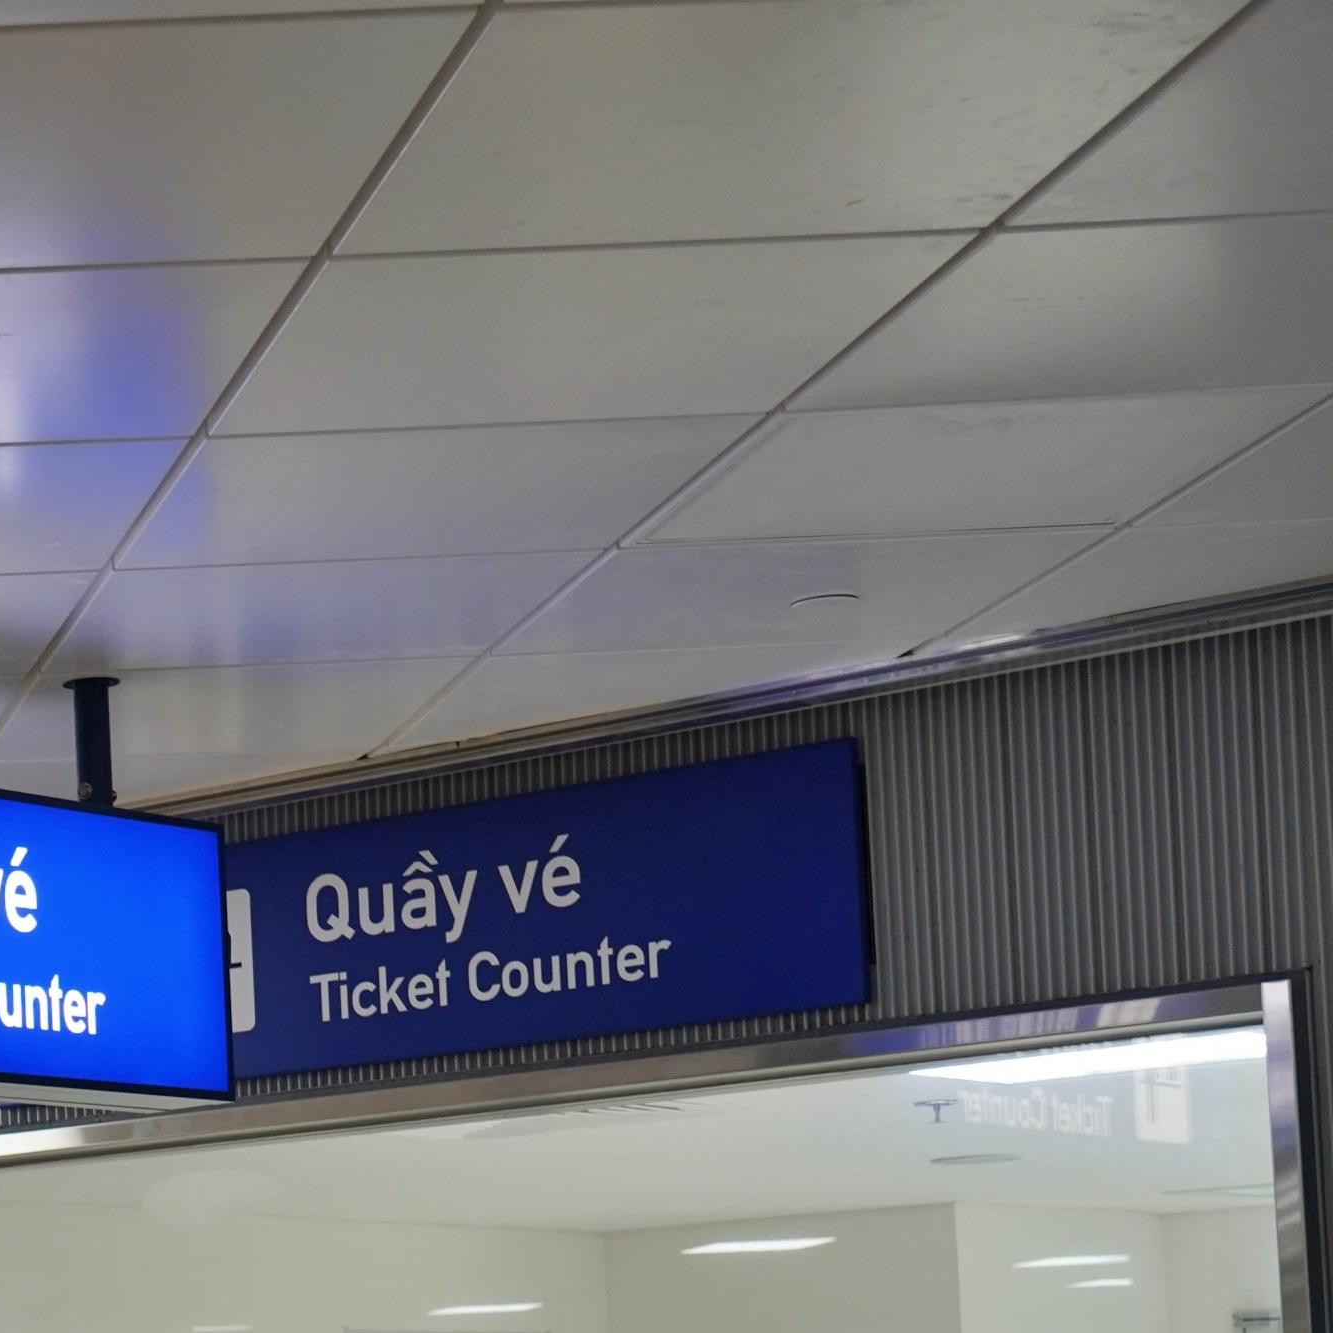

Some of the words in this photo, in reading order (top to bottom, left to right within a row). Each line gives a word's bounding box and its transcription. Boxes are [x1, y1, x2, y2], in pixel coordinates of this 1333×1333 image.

[305, 849, 478, 943] Quầy
[497, 833, 581, 914] vé
[309, 958, 451, 1022] Ticket
[468, 936, 672, 1001] Counter
